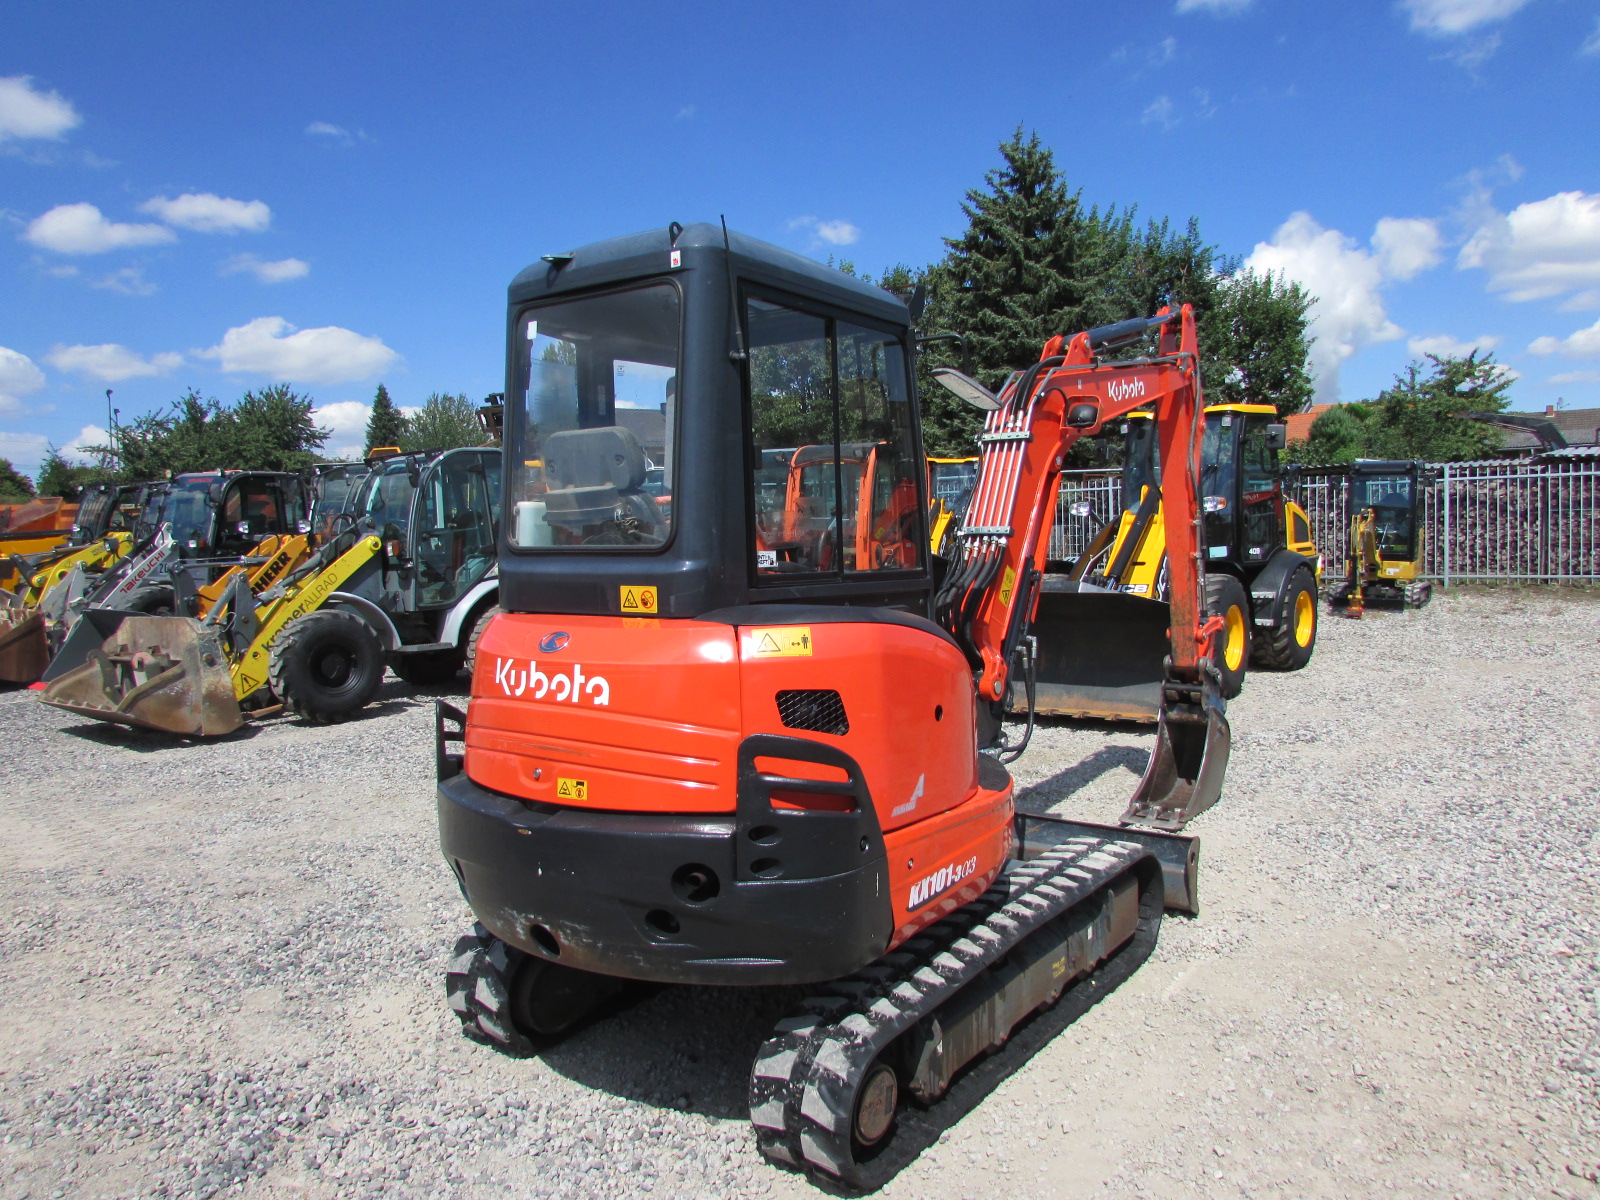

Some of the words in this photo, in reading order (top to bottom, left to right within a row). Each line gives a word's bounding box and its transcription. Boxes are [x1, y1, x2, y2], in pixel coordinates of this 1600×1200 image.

[1107, 377, 1145, 402] Kubota
[1117, 584, 1149, 593] JCB
[495, 657, 610, 705] Kubota
